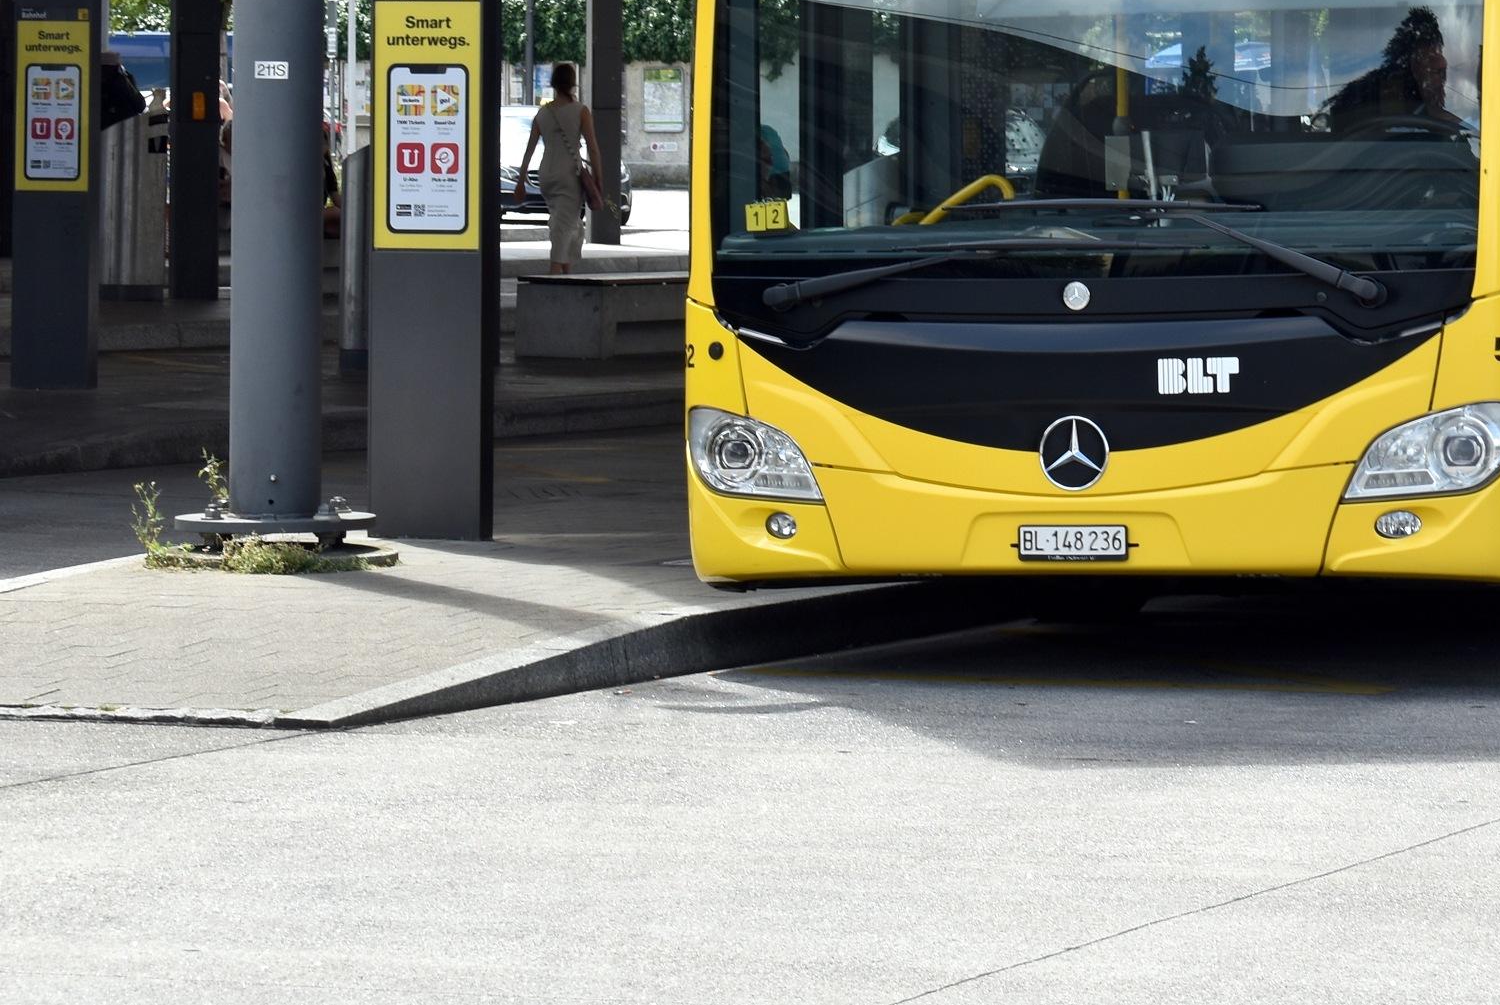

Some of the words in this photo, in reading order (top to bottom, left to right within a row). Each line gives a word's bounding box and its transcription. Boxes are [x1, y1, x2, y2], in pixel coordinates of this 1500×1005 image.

[405, 15, 452, 29] Smart
[38, 30, 70, 40] Smart
[386, 34, 470, 49] unterwegs.
[25, 43, 82, 54] unterwegs.
[1157, 357, 1240, 394] BLT
